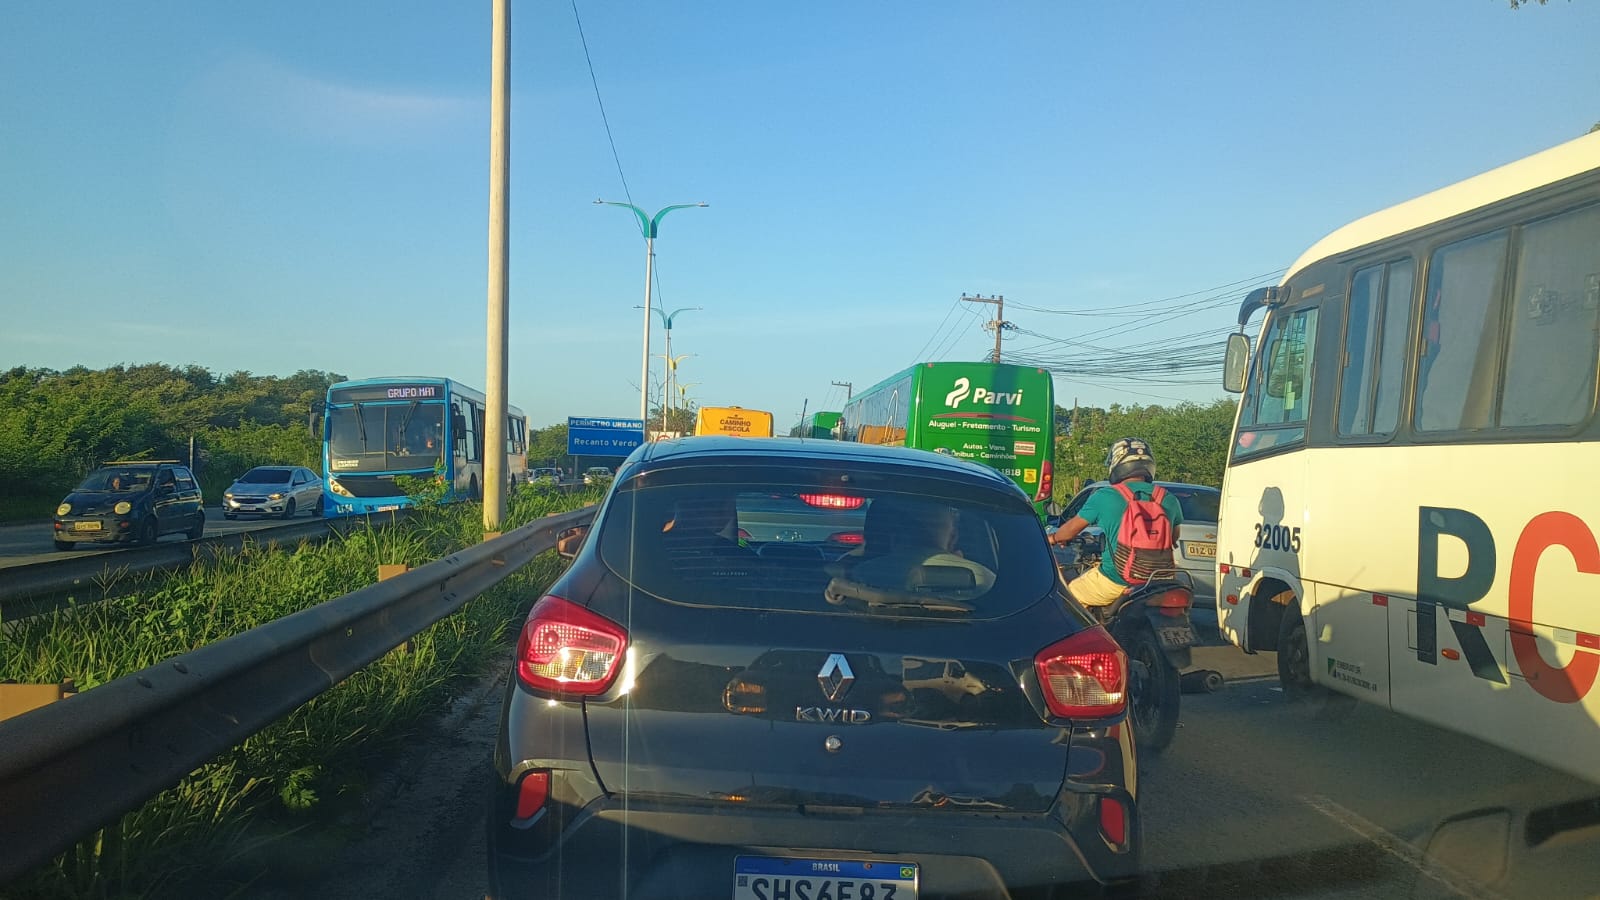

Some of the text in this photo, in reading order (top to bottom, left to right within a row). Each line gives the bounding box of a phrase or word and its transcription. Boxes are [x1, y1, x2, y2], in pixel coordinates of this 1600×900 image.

[388, 388, 416, 398] GRUPO
[972, 387, 1023, 406] Parvi
[570, 418, 643, 429] PERÍMETRO URBANO
[928, 420, 957, 430] Aluguel
[962, 421, 1006, 431] Fretamento
[1012, 424, 1041, 433] Turismo
[574, 438, 638, 447] Recanto Verde
[980, 452, 1017, 460] Caminhões
[1254, 522, 1301, 553] 32005
[796, 706, 872, 725] KWID
[812, 862, 840, 872] BRASIL
